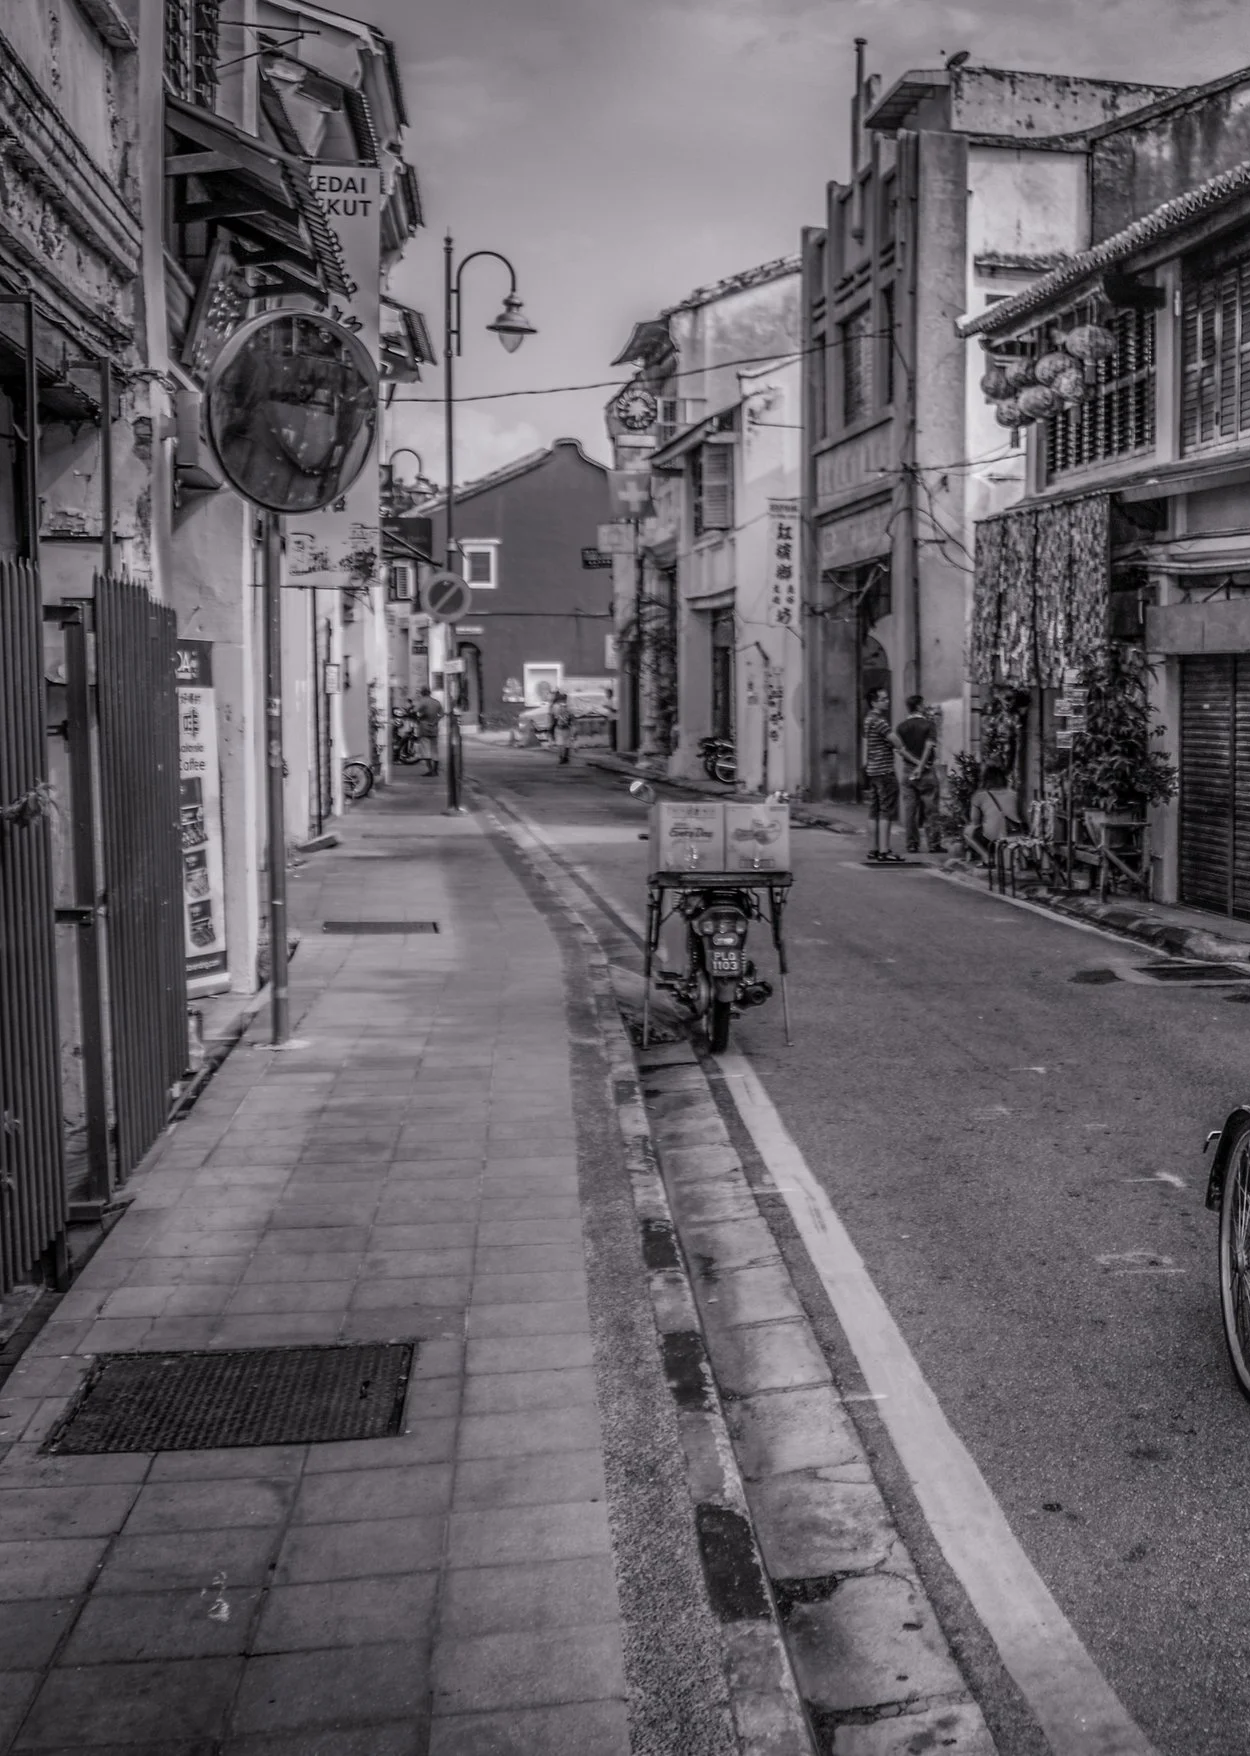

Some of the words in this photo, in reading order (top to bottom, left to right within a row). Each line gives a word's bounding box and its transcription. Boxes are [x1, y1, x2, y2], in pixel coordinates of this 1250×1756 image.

[311, 175, 366, 194] EDAI
[319, 199, 372, 217] KUT
[712, 961, 738, 970] 1103
